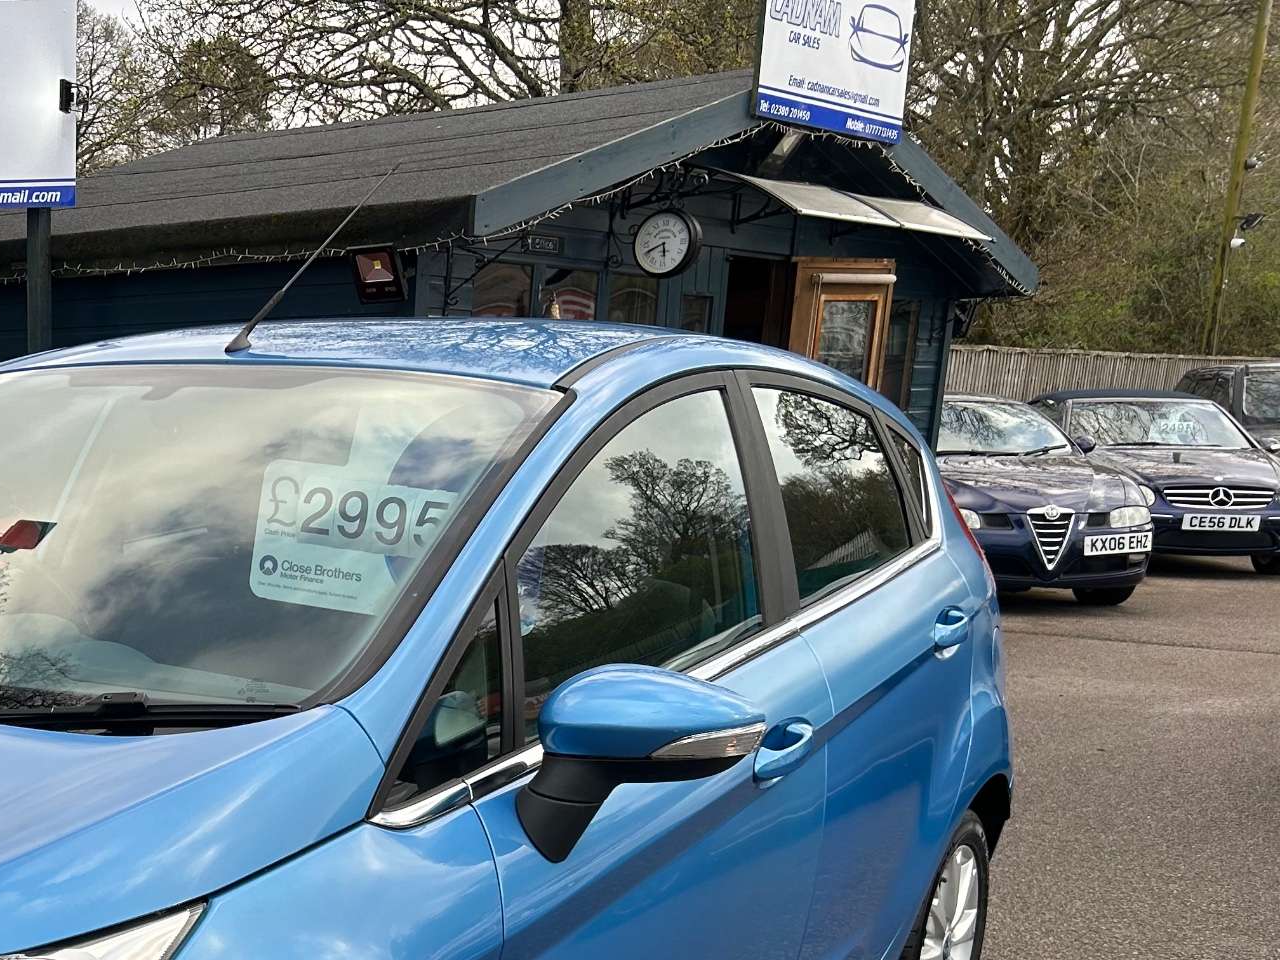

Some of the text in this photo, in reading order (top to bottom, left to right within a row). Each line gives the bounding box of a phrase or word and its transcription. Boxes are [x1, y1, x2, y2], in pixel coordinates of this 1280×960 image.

[770, 0, 841, 38] CADNAM
[788, 30, 821, 50] CAR SALES
[1189, 516, 1255, 529] CE56 DLK
[1090, 534, 1150, 553] KX06 EHZ
[281, 559, 362, 582] Close Brothers
